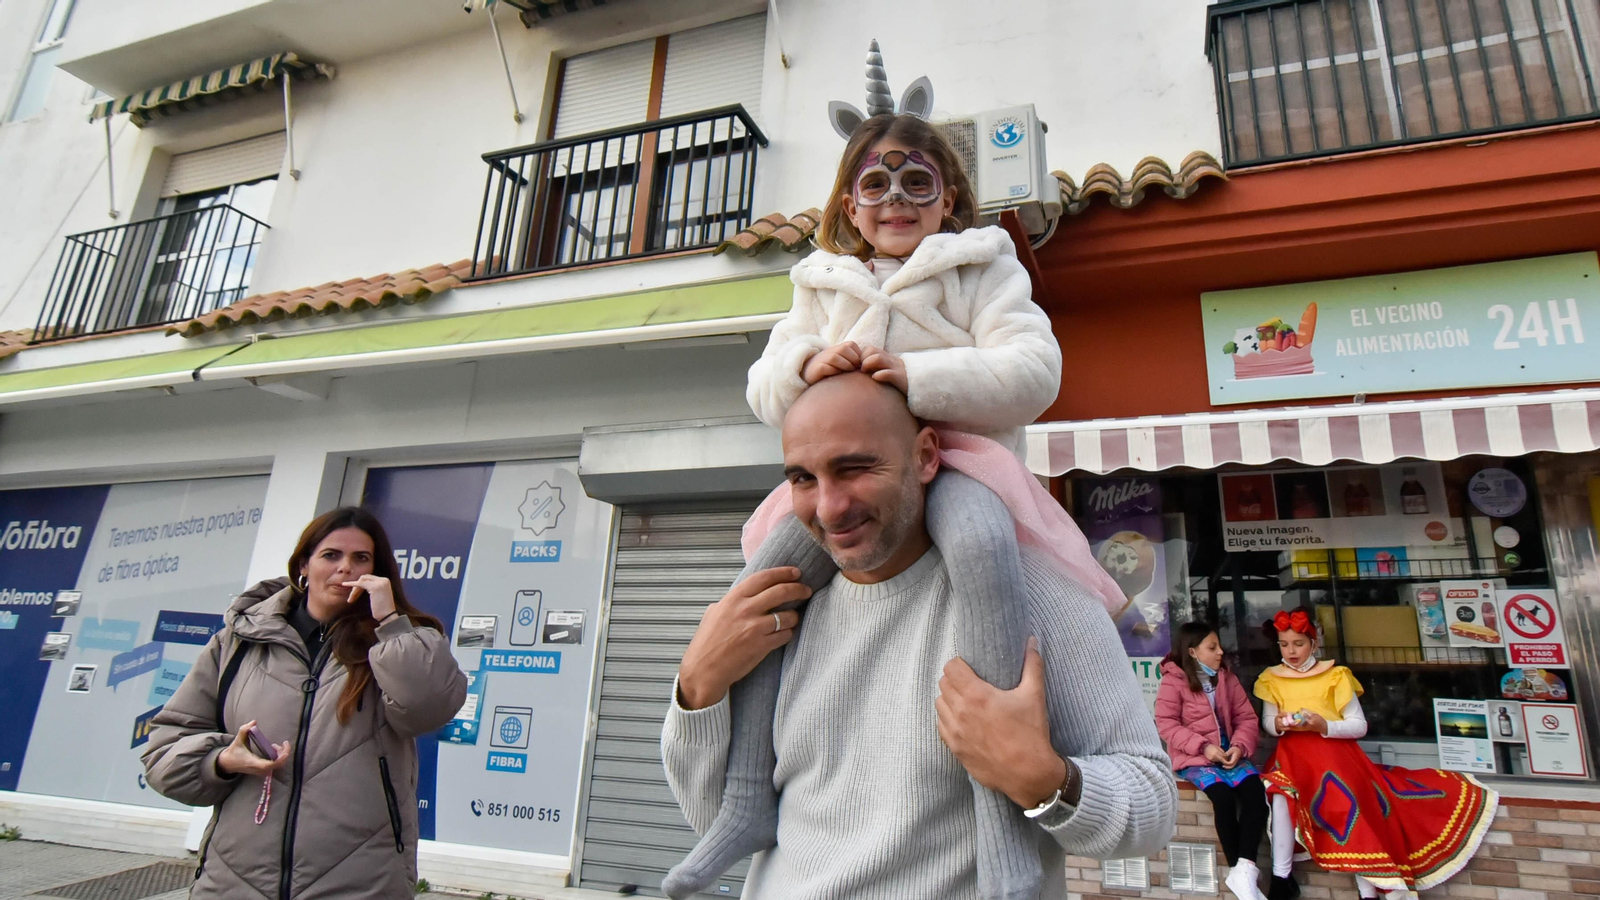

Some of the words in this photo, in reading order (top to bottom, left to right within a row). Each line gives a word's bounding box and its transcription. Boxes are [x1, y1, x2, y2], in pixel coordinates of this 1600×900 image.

[1350, 309, 1372, 327] EL
[1376, 301, 1444, 323] VECINO
[1487, 298, 1585, 350] 24H
[1335, 325, 1470, 357] ALIMENTACIÓN
[1088, 479, 1154, 512] Milka
[108, 524, 159, 548] Tenemos
[159, 515, 205, 539] nuestra
[204, 505, 246, 537] propia
[1227, 527, 1264, 535] Nueva
[1266, 526, 1313, 535] imagen.
[513, 545, 557, 557] PACKS
[1228, 538, 1256, 547] Elige
[1260, 537, 1272, 545] tu
[1275, 536, 1325, 545] favorita.
[97, 561, 114, 583] de
[114, 558, 140, 580] fibra
[142, 552, 180, 581] óptica
[0, 588, 53, 605] blemos
[485, 655, 556, 668] TELEFONIA
[490, 756, 522, 768] FIBRA
[487, 802, 508, 817] 851
[512, 805, 534, 820] 000
[538, 809, 560, 823] 515
